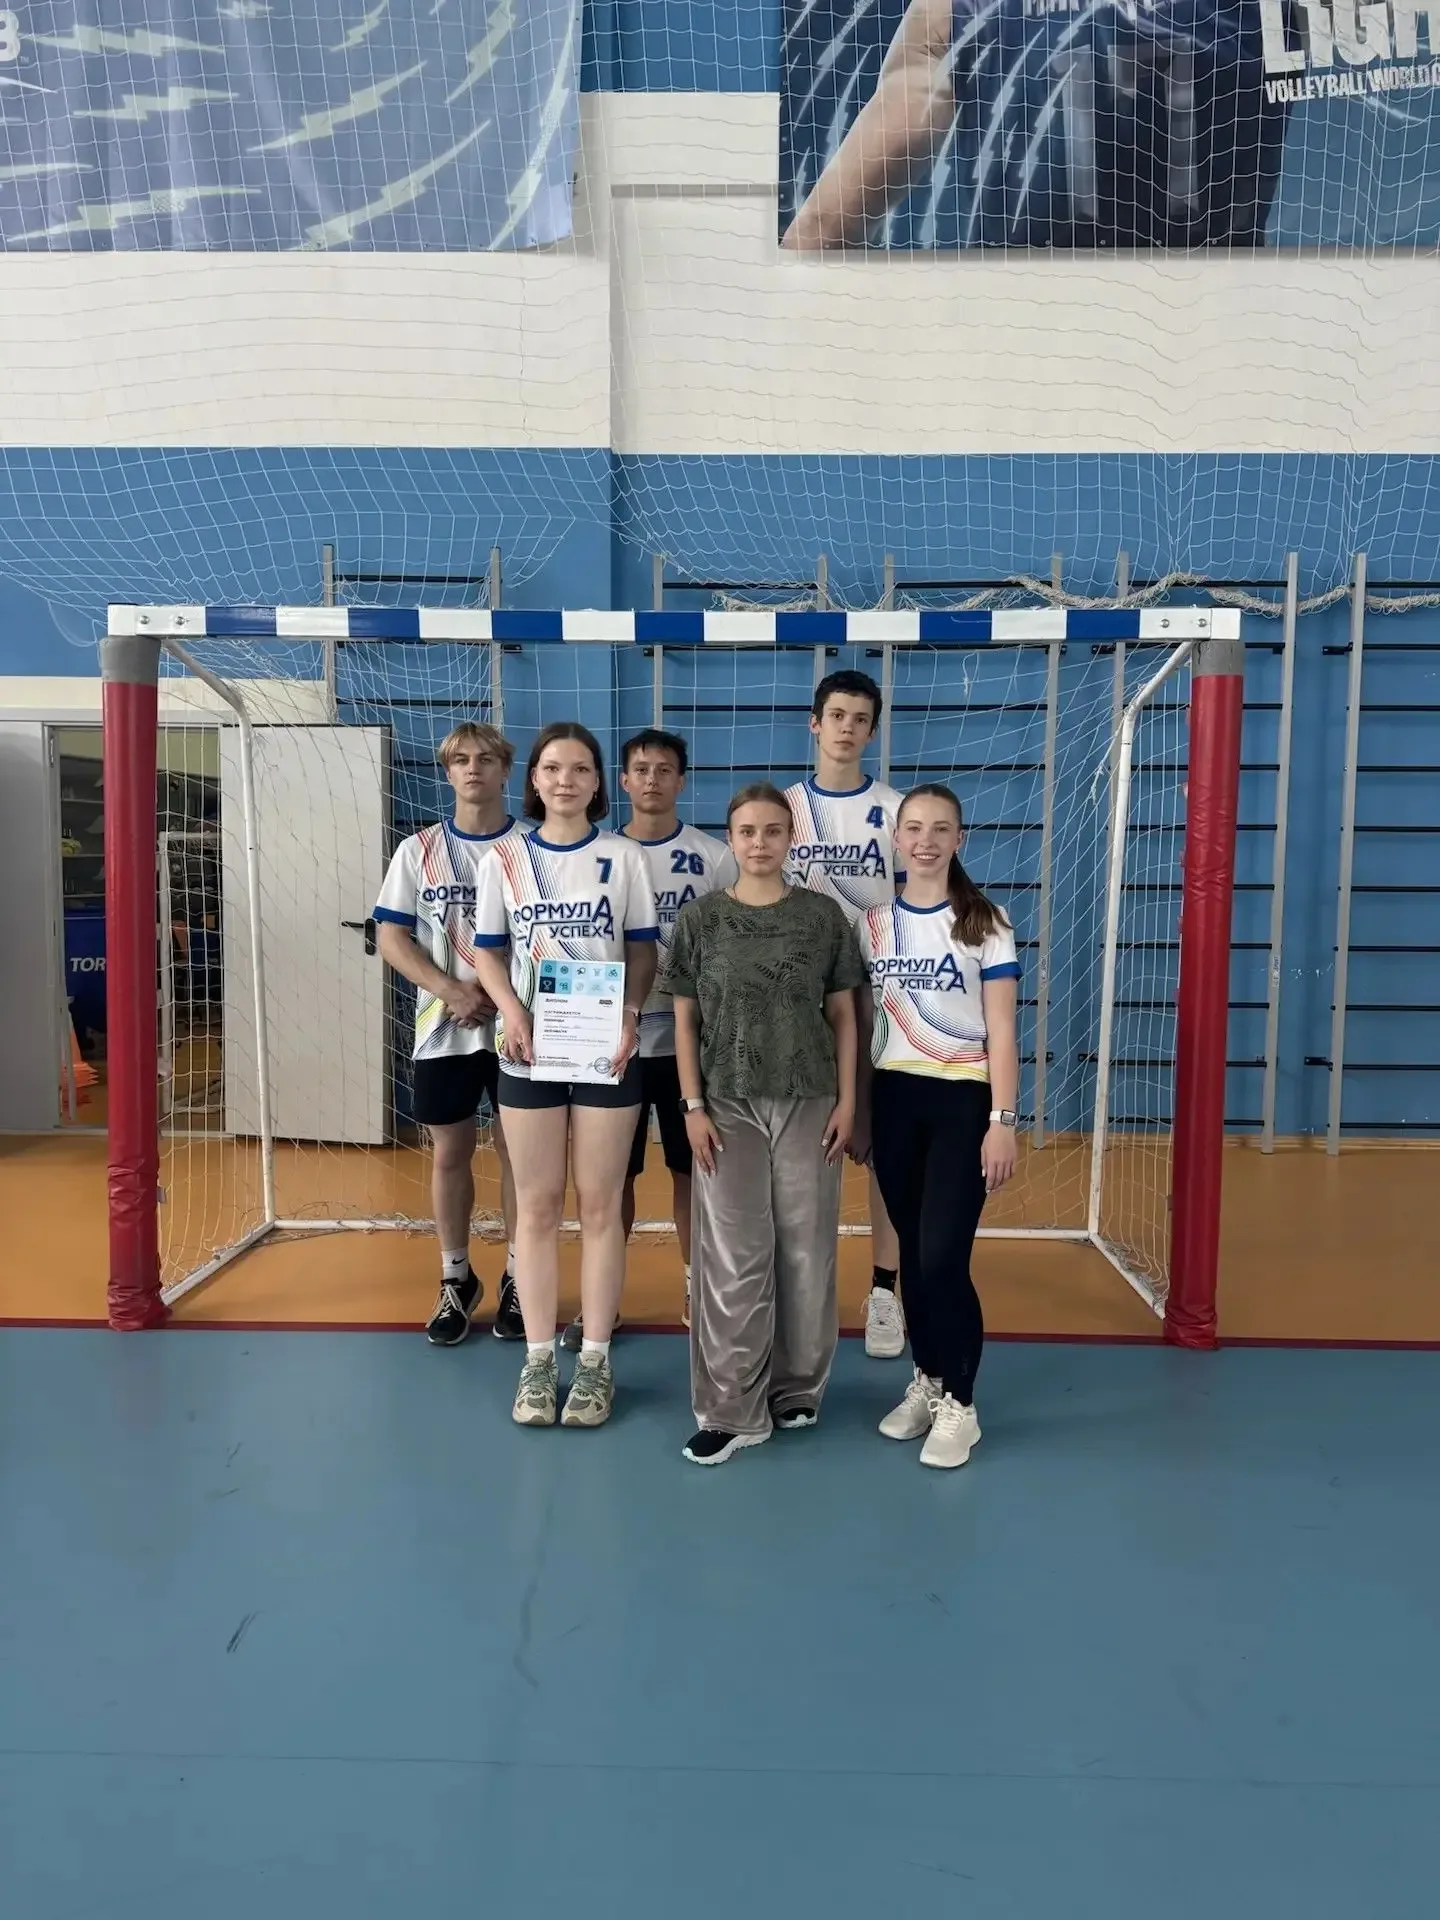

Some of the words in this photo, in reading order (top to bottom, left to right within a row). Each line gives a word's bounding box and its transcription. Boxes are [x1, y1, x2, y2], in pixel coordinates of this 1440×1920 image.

[1265, 71, 1367, 104] VOLLEYBALL
[1367, 65, 1430, 93] WORLD
[866, 805, 884, 829] 4
[596, 857, 613, 884] 7
[670, 849, 704, 876] 26
